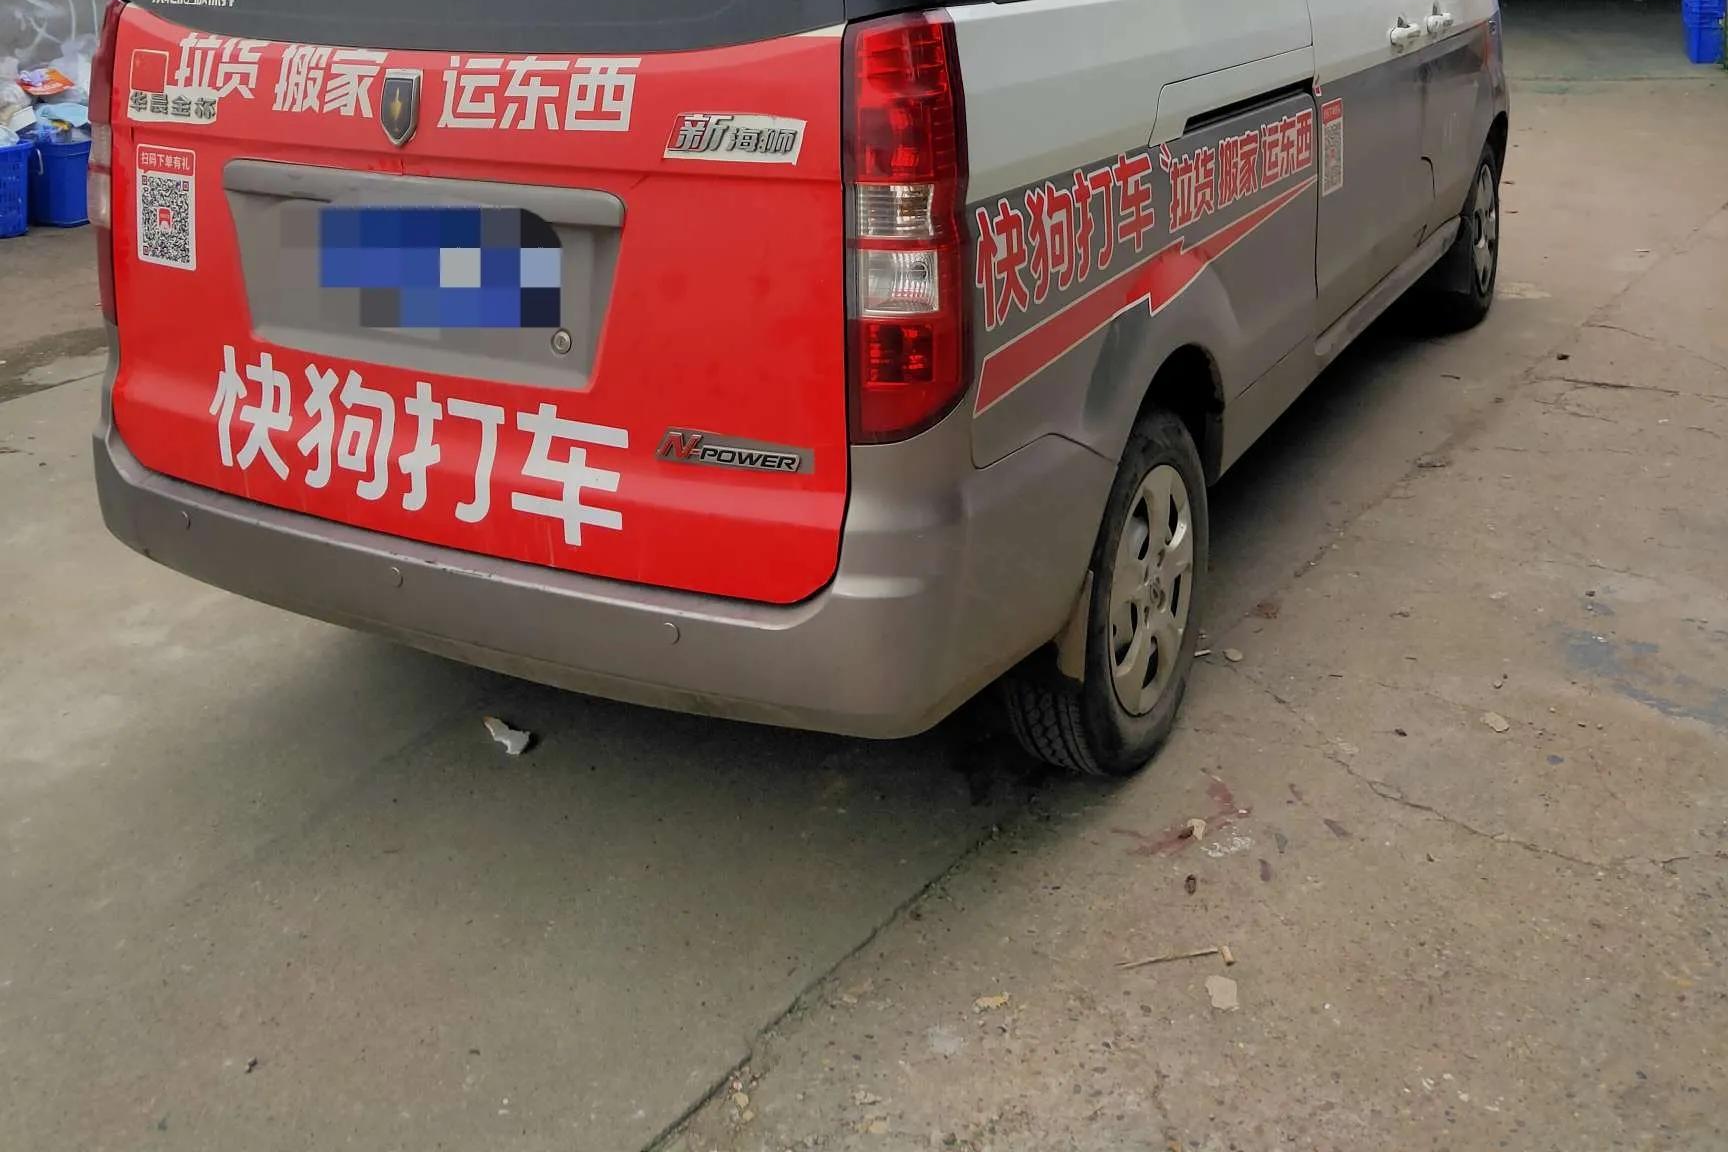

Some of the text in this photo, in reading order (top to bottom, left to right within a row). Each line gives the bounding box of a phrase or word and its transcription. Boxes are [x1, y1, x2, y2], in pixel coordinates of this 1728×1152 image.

[129, 91, 216, 120] 华晨金杯
[175, 32, 642, 132] 拉货 搬家 运东西
[671, 113, 798, 155] 新海狮
[976, 108, 1314, 331] 快狗打车 拉货 搬家 运东西
[209, 344, 630, 547] 快狗打车
